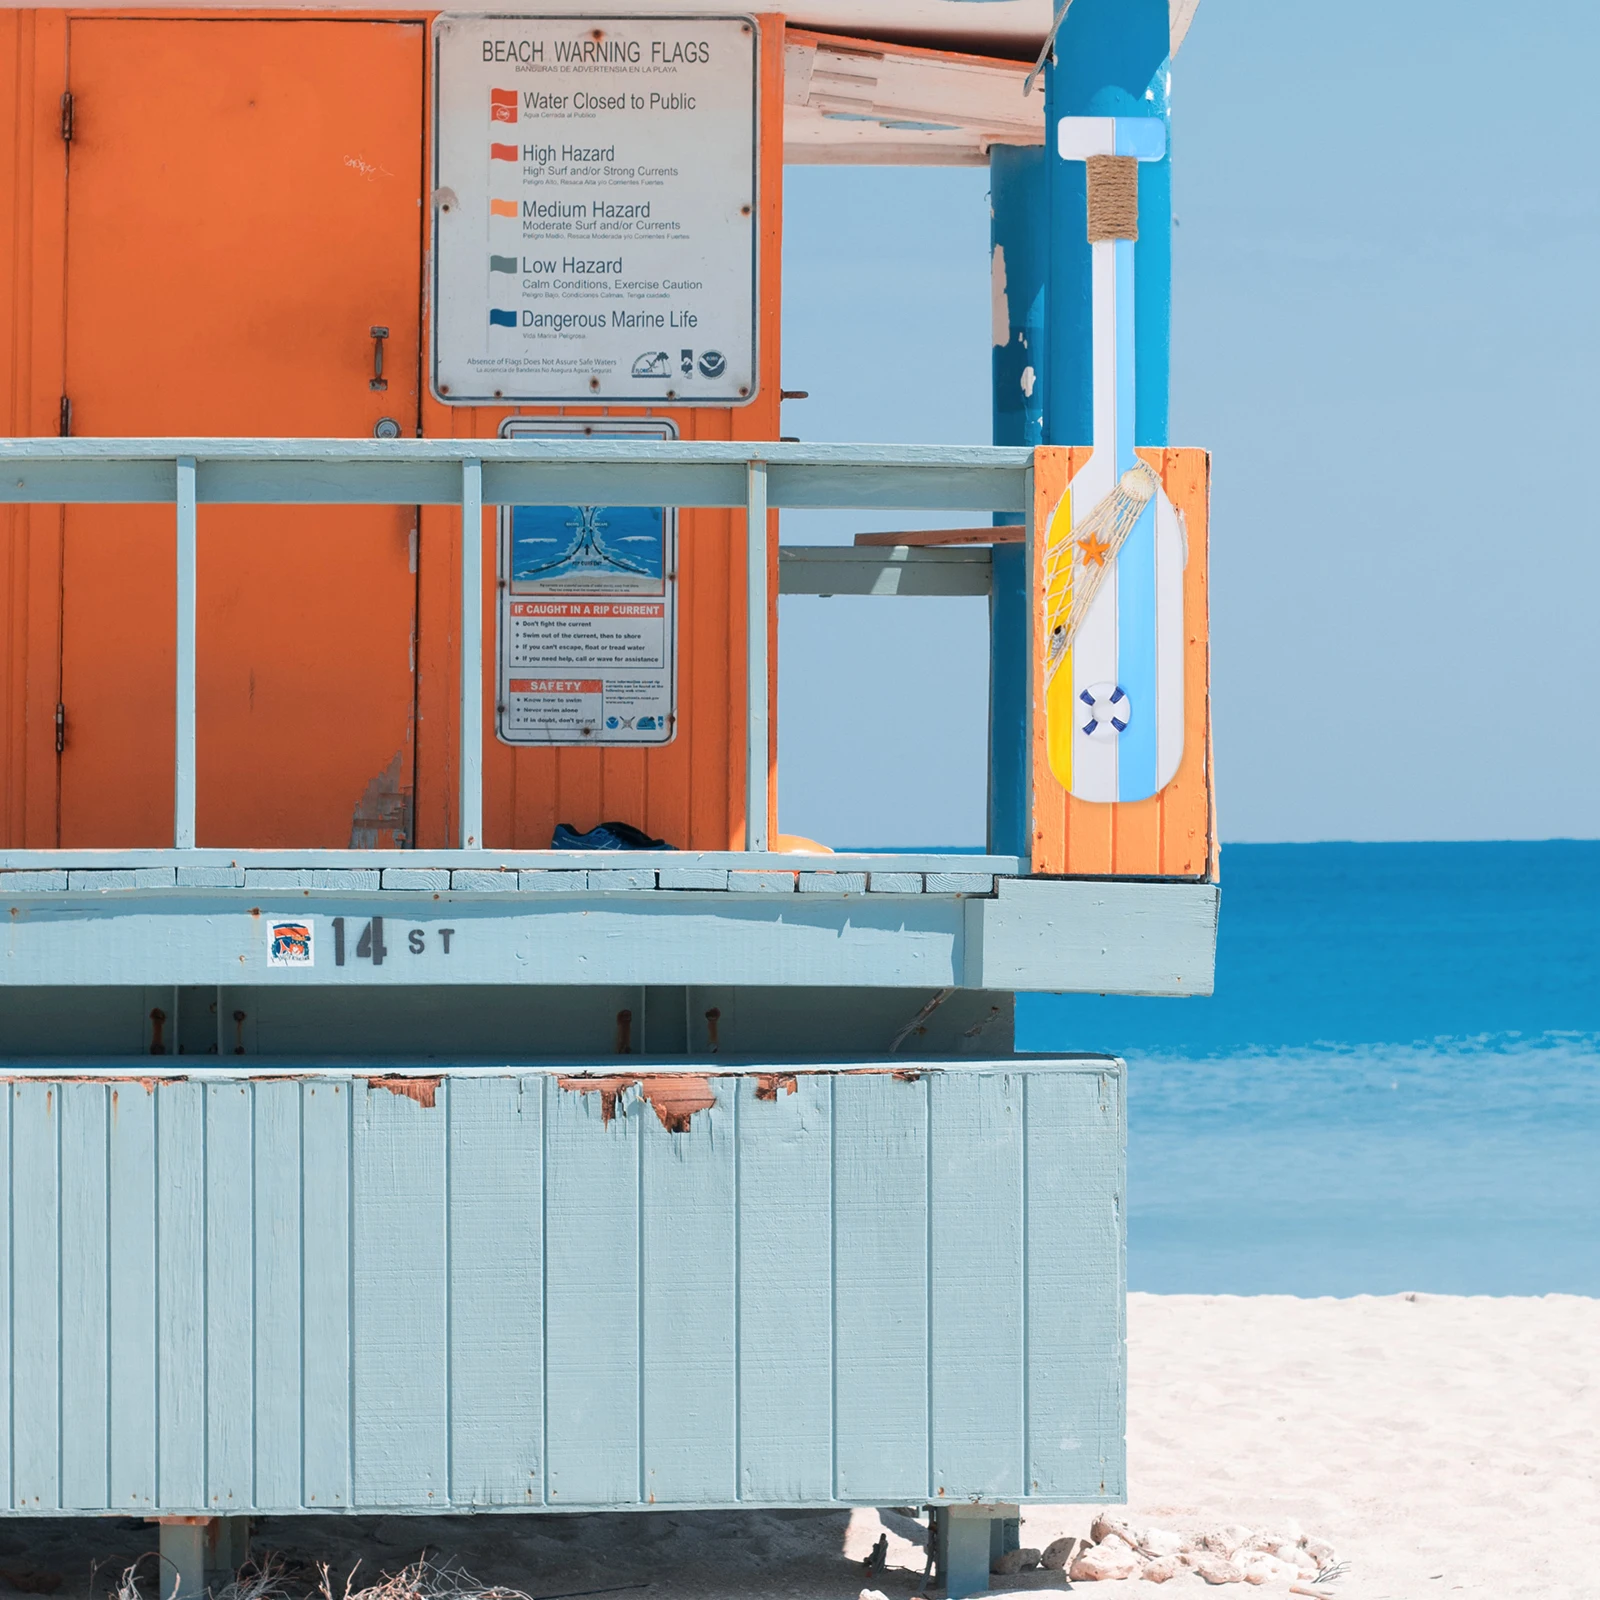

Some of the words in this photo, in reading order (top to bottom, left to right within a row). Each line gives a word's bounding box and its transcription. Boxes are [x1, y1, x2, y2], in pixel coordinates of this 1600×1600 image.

[482, 40, 544, 63] BEACH
[555, 40, 641, 63] WARNING
[651, 40, 710, 63] FLAGS
[560, 65, 571, 73] DE
[572, 65, 628, 73] ADVERTENSIA
[629, 65, 640, 73] EN
[642, 65, 652, 73] LA
[653, 65, 677, 73] PLAYA
[524, 92, 569, 110] Water
[573, 92, 626, 110] Closed
[630, 92, 645, 110] to
[650, 92, 696, 110] Public
[523, 144, 556, 166] High
[562, 144, 615, 162] Hazard
[523, 166, 545, 178] High
[548, 166, 568, 176] Surf
[570, 166, 600, 176] and/or
[603, 166, 635, 178] Strong
[638, 166, 678, 176] Currents
[522, 201, 586, 218] Medium
[592, 201, 651, 218] Hazard
[523, 220, 572, 230] Moderate
[575, 220, 597, 230] Surf
[600, 220, 633, 230] and/or
[636, 220, 680, 230] Currents
[522, 257, 556, 274] Low
[563, 257, 623, 274] Hazard
[522, 280, 550, 289] Calm
[553, 280, 612, 291] Conditions,
[614, 280, 659, 289] Exercise
[662, 280, 703, 289] Caution
[522, 310, 606, 332] Dangerous
[612, 310, 665, 328] Marine
[670, 310, 698, 328] Life
[504, 358, 523, 367] Flags
[514, 605, 523, 615] IF
[527, 605, 566, 615] CAUGHT
[570, 605, 580, 615] IN
[583, 605, 590, 615] A
[593, 605, 609, 615] RIP
[612, 605, 660, 615] CURRENT
[531, 682, 581, 690] SAFETY
[332, 917, 387, 966] 14
